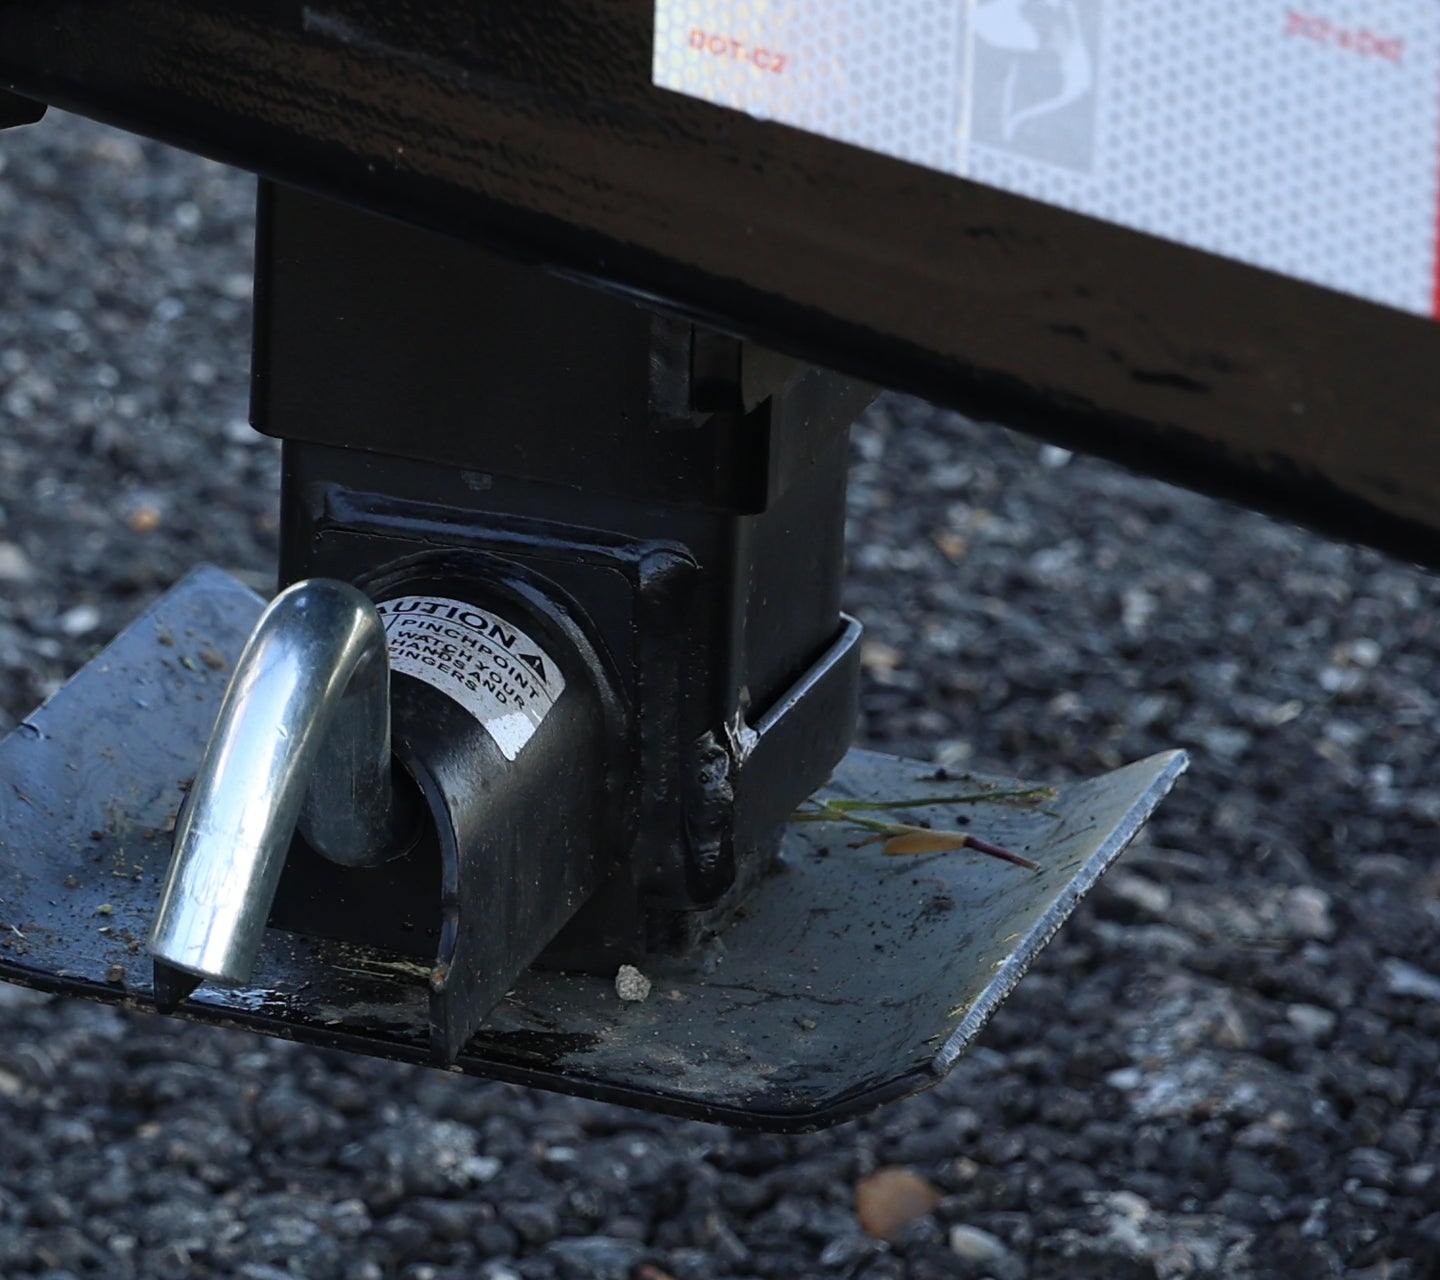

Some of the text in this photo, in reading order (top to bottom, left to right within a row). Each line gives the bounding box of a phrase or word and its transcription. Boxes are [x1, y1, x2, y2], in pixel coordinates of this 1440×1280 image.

[688, 27, 789, 76] DOT-C2
[376, 601, 517, 649] UTION
[390, 638, 508, 705] HANDS AND
[397, 630, 526, 710] WATCH YOUR
